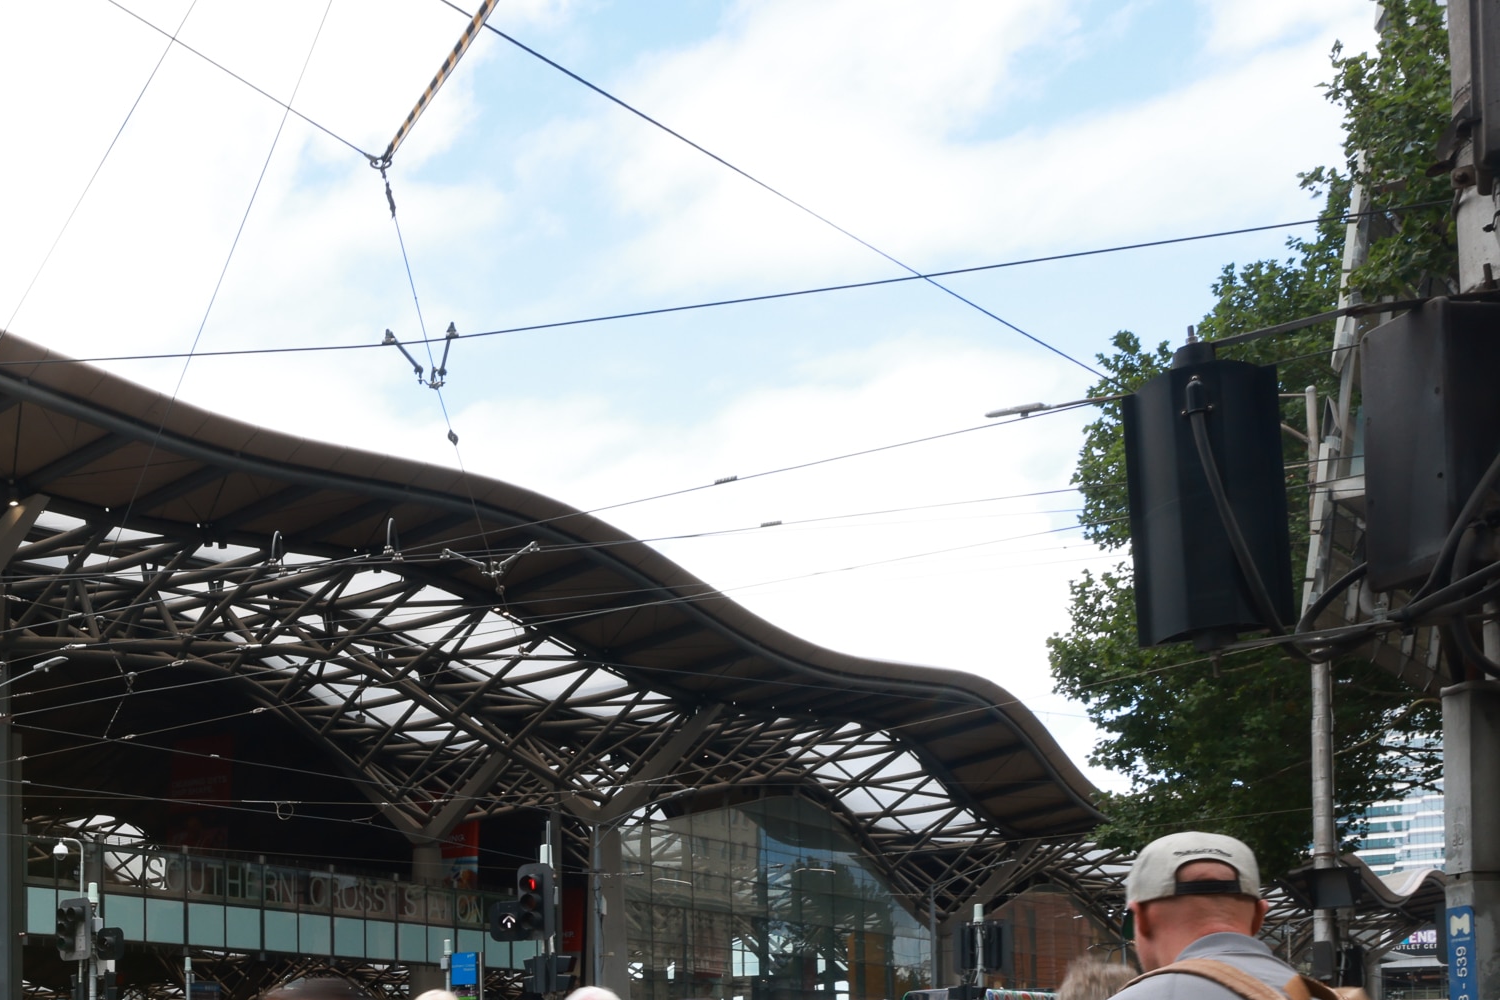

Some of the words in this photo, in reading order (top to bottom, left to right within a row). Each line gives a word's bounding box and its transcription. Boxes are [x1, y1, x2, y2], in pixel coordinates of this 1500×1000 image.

[147, 856, 296, 905] SOUTHERN
[310, 876, 387, 914] CROSS
[1455, 946, 1468, 978] 539
